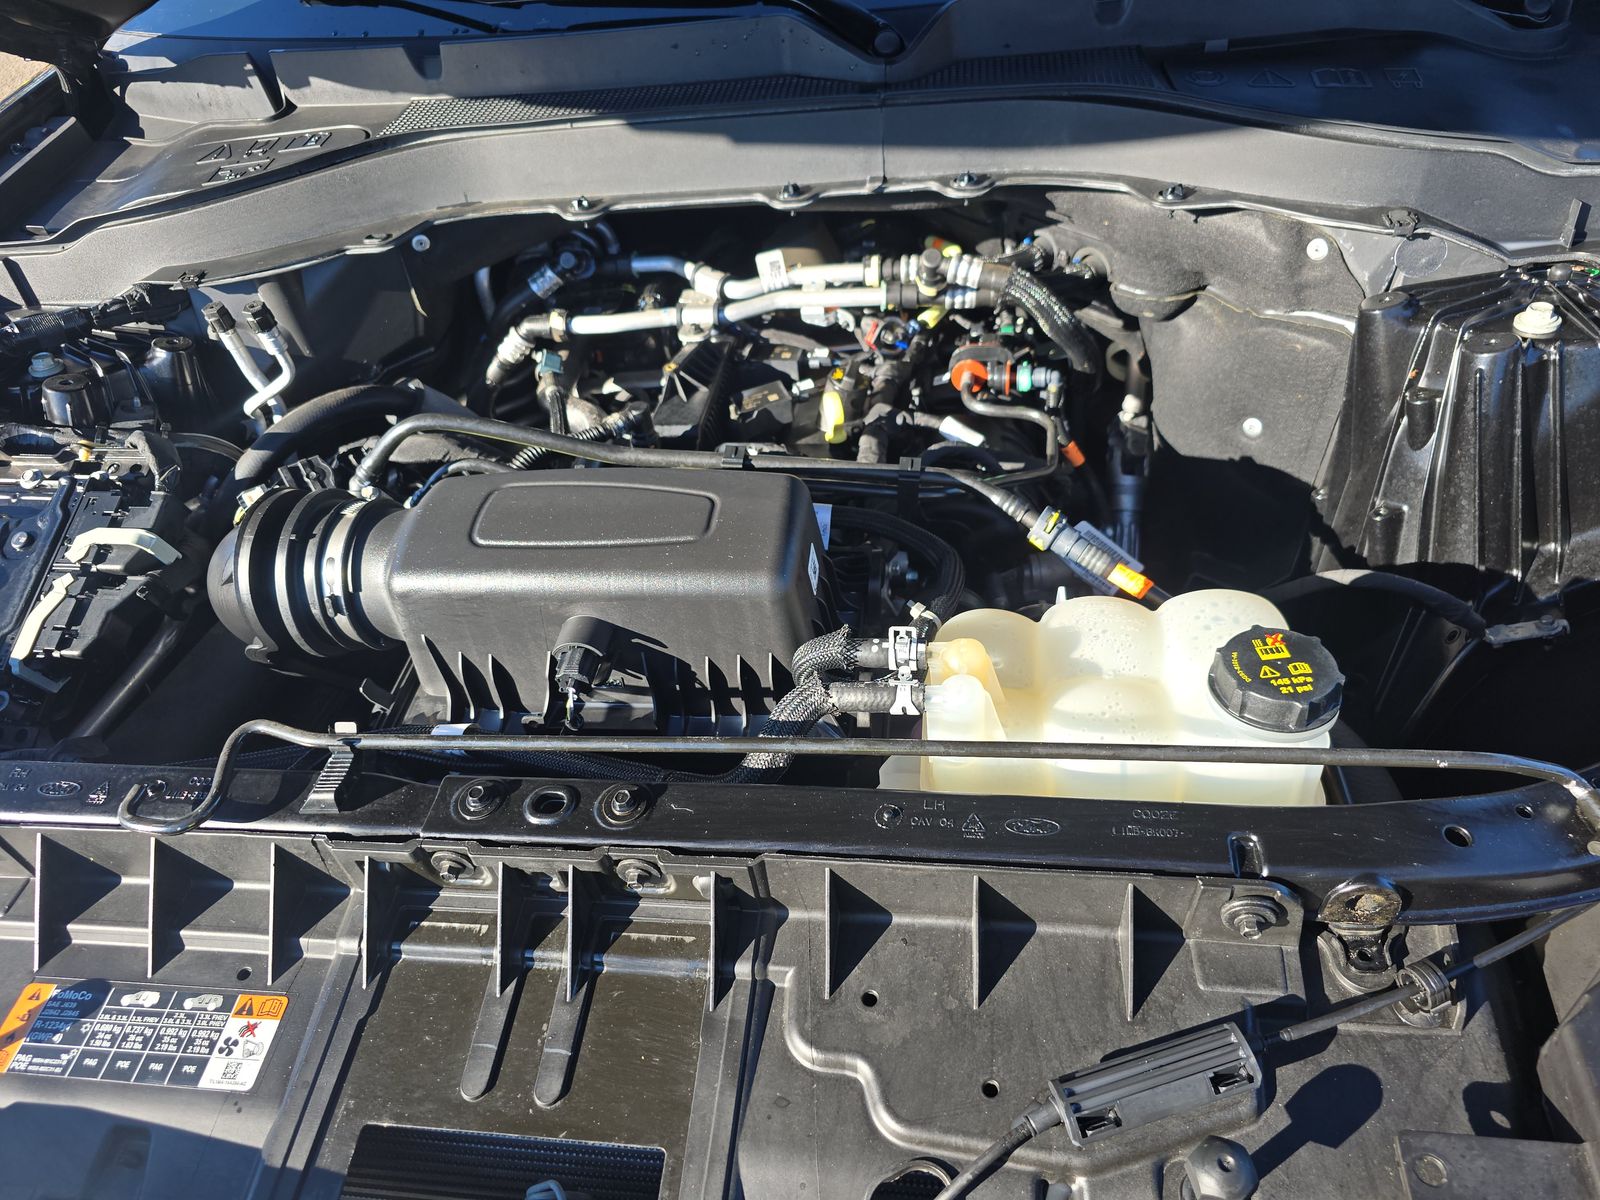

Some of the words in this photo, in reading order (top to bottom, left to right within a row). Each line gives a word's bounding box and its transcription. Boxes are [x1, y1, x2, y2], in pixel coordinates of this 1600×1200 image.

[1270, 677, 1291, 687] 145
[1291, 676, 1313, 684] kPa
[1279, 686, 1294, 694] 21
[1296, 684, 1313, 693] psi
[923, 799, 945, 811] LH
[51, 988, 93, 1000] FoMoCo
[112, 1025, 122, 1034] kg
[126, 1025, 145, 1033] 0.737
[144, 1027, 154, 1036] kg
[178, 1028, 188, 1037] kg
[210, 1030, 220, 1040] kg
[14, 1054, 33, 1063] PAG
[83, 1058, 98, 1066] PAG
[10, 1061, 29, 1070] POE
[116, 1060, 131, 1068] POE
[149, 1062, 163, 1070] PAG
[181, 1065, 197, 1073] POE
